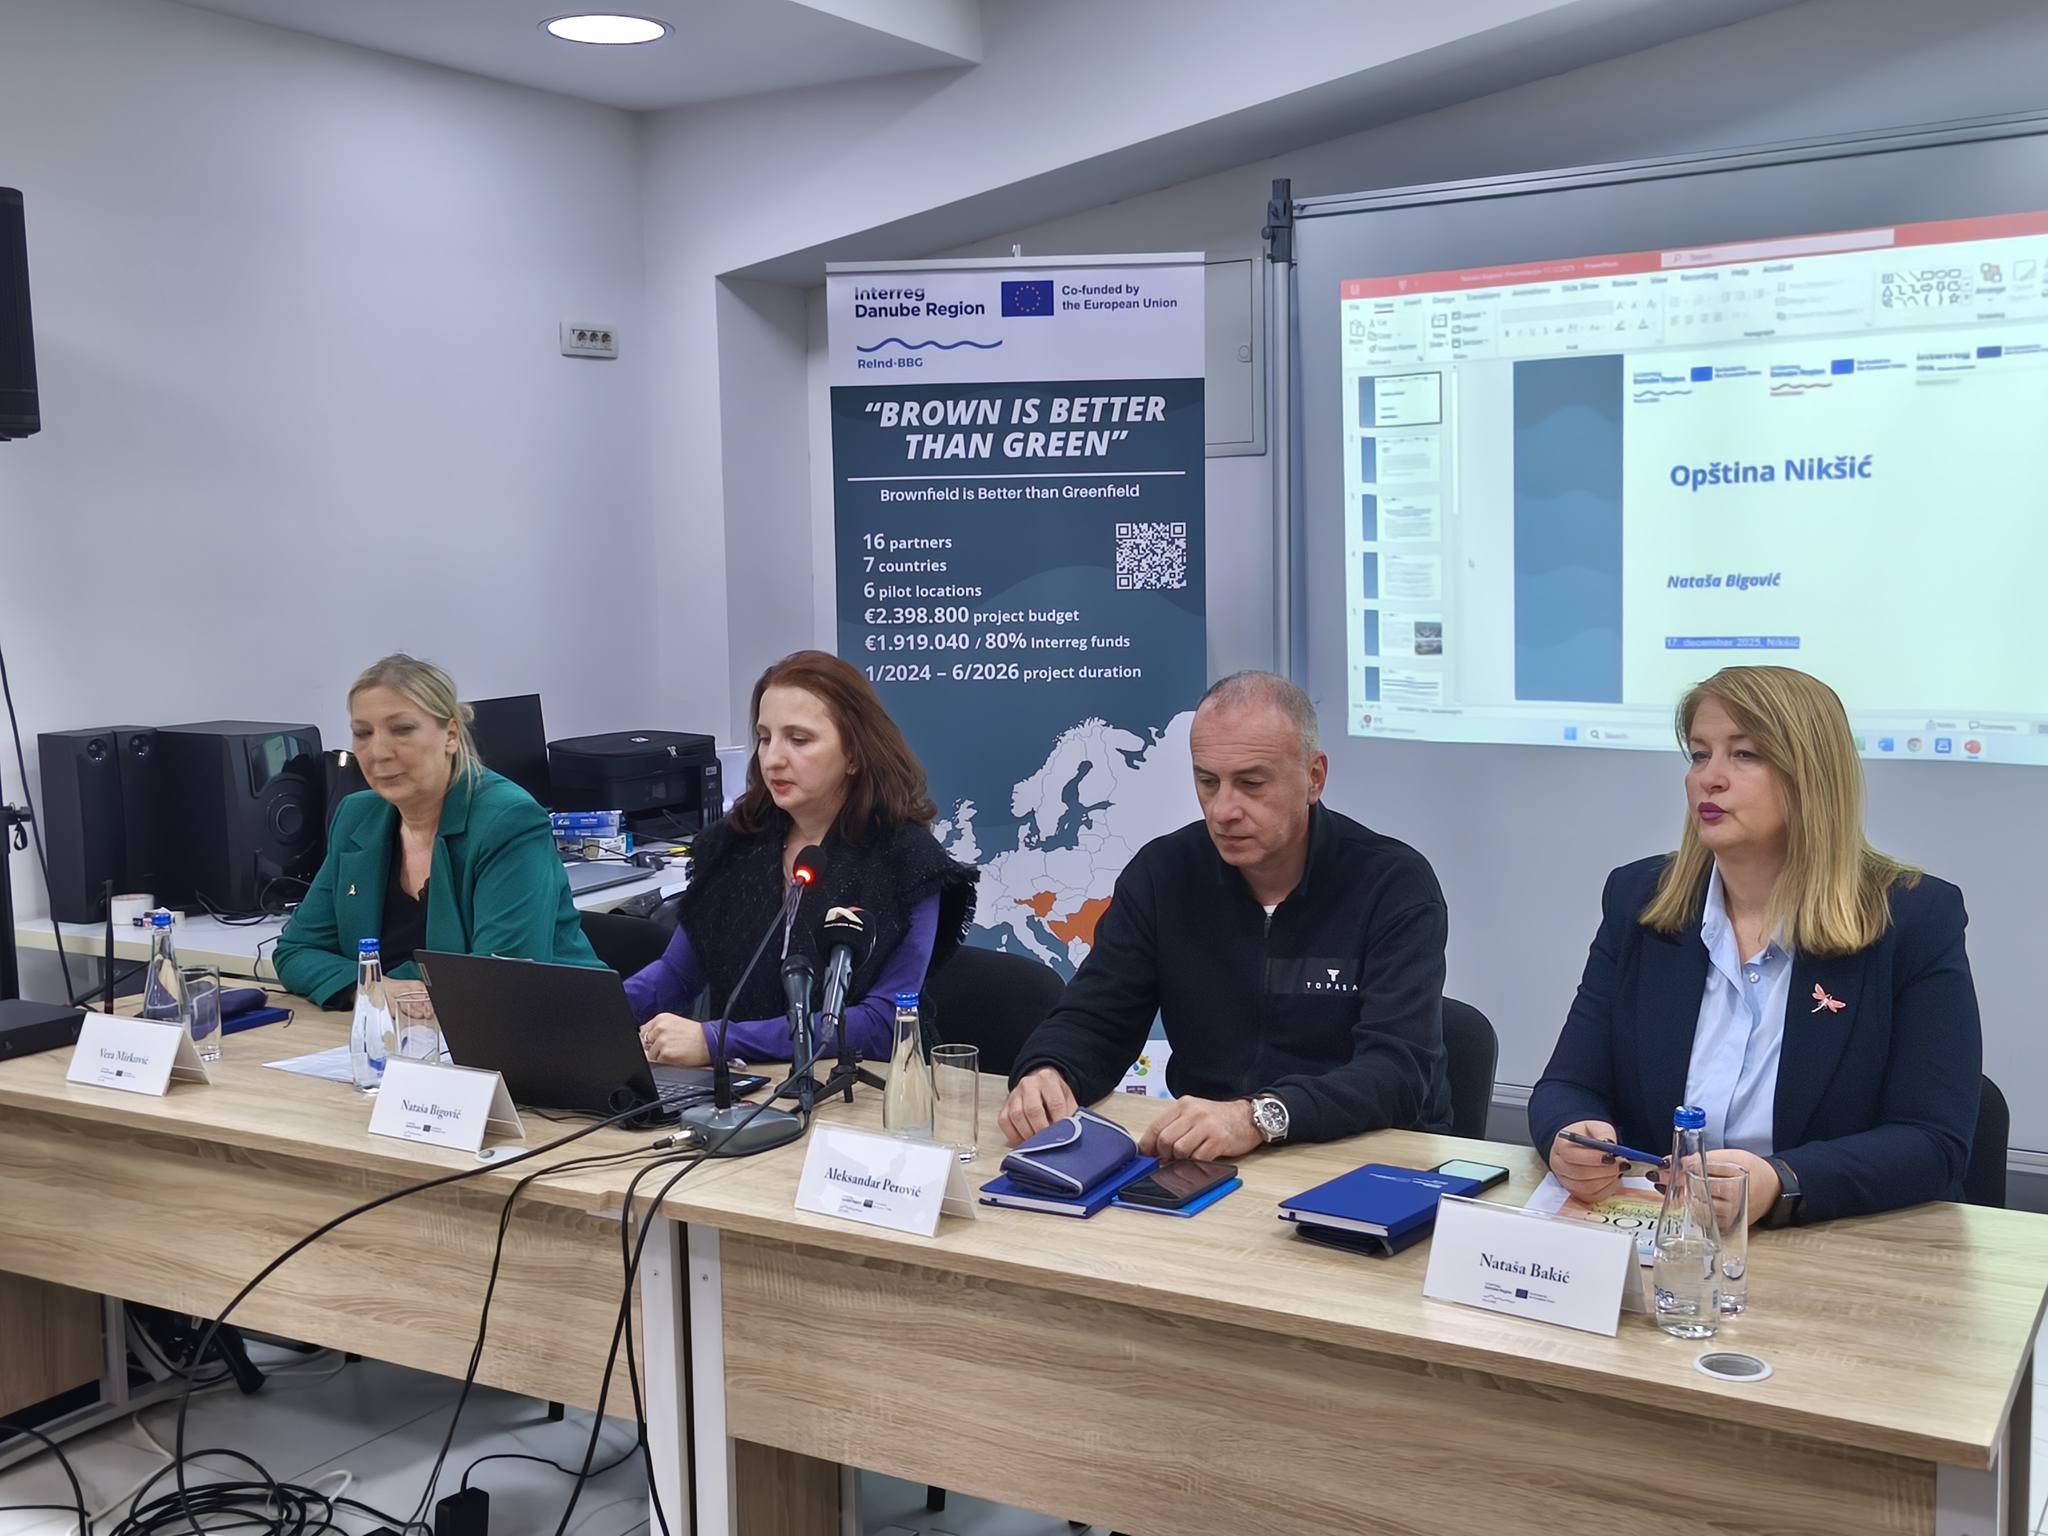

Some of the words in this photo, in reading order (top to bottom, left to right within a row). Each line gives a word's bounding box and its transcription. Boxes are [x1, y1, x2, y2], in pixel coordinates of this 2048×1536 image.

[1062, 284, 1122, 296] Co-funded
[1126, 283, 1139, 296] by
[855, 302, 921, 318] Danube
[926, 302, 985, 318] Region
[1062, 299, 1081, 311] the
[1084, 298, 1140, 311] European
[1143, 297, 1177, 309] Union
[1010, 399, 1040, 425] IS
[1050, 396, 1166, 424] BETTER
[905, 433, 993, 460] THAN
[1670, 462, 1775, 492] Opština
[1784, 455, 1873, 481] Nikšić
[880, 488, 959, 502] Brownfield
[962, 487, 975, 500] is
[978, 487, 1022, 500] Better
[1025, 486, 1058, 499] than
[1062, 484, 1140, 499] Greenfield
[863, 533, 885, 550] 16
[889, 536, 952, 552] partners
[863, 556, 875, 573] 7
[878, 559, 947, 573] countries
[1667, 574, 1722, 588] Nataša
[1726, 572, 1781, 591] Bigović
[863, 582, 875, 598] 6
[879, 585, 912, 601] pilot
[915, 584, 982, 598] locations
[864, 607, 969, 625] €2.398.800
[973, 610, 1023, 626] project
[1028, 609, 1080, 624] budget
[865, 633, 969, 651] €1.919.040
[985, 632, 1027, 649] 80%
[1031, 636, 1088, 651] Interreg
[1091, 635, 1130, 648] funds
[865, 664, 931, 683] 1/2024
[952, 663, 1019, 681] 6/2026
[1023, 668, 1075, 683] project
[1078, 666, 1142, 679] duration
[400, 1099, 428, 1114] Nataša
[430, 1104, 462, 1120] Bigović
[824, 1167, 881, 1189] Aleksandar
[1480, 1252, 1526, 1275] Nataša
[1530, 1262, 1571, 1284] Bakić
